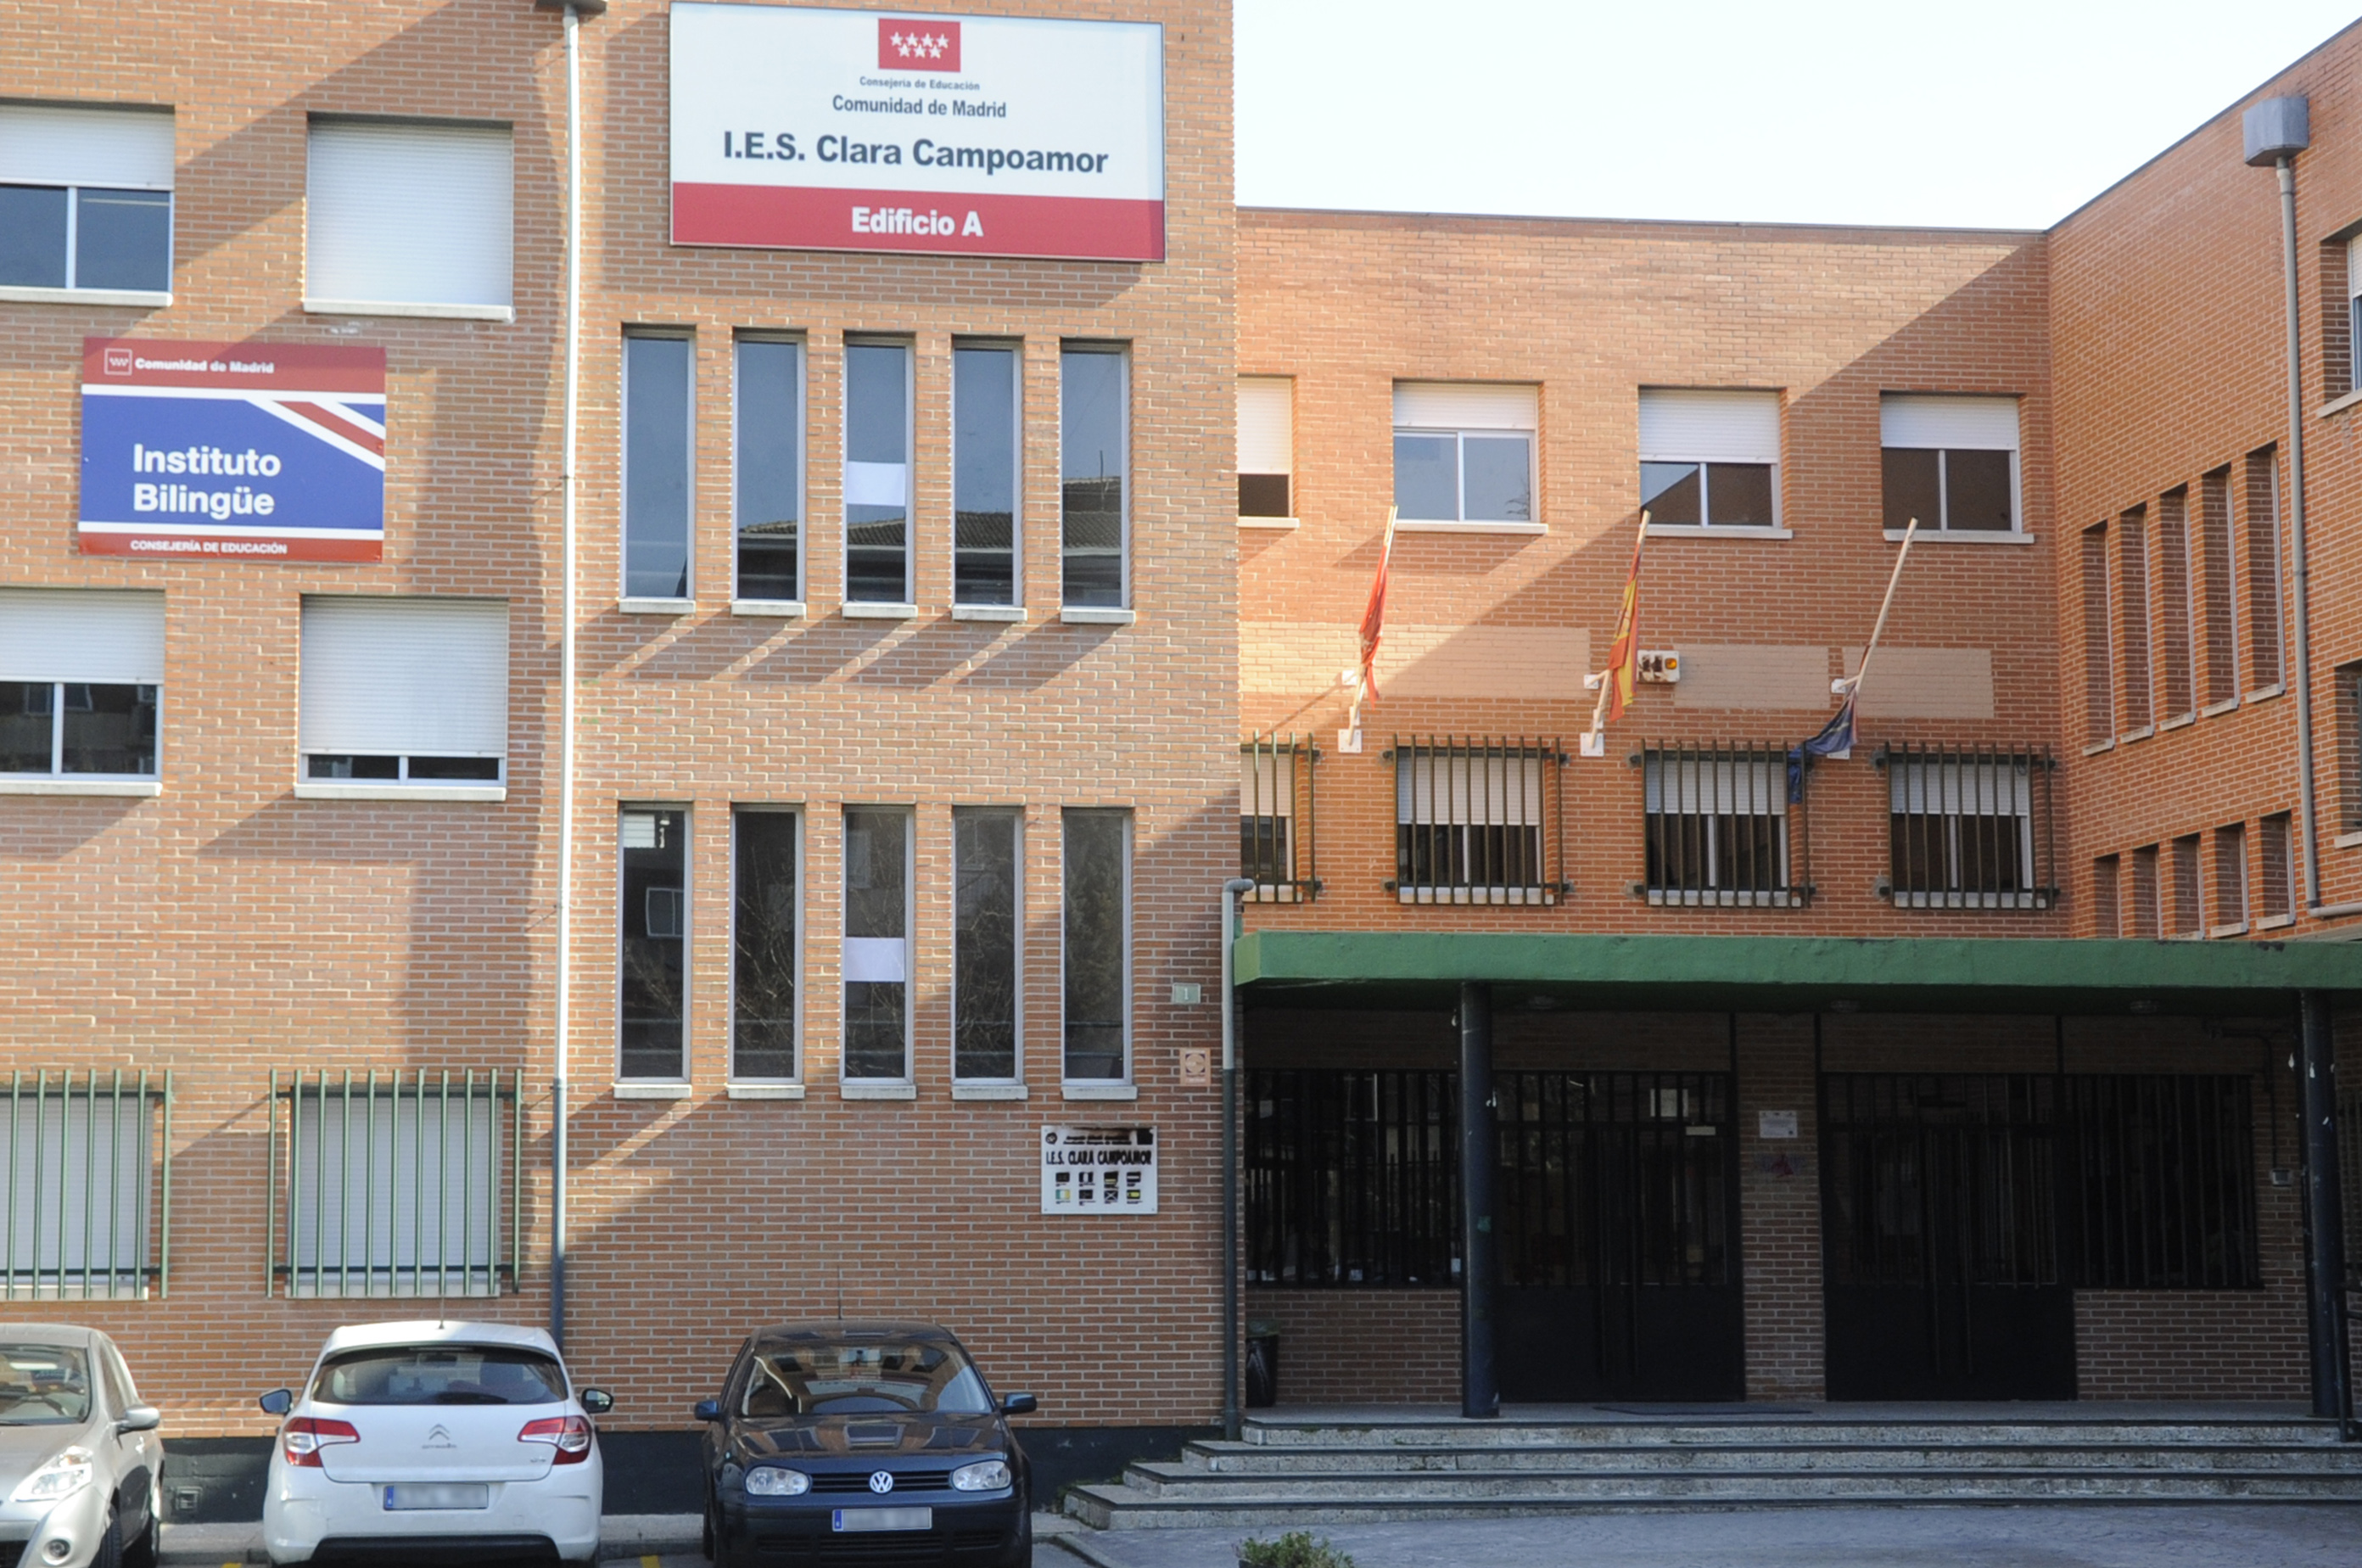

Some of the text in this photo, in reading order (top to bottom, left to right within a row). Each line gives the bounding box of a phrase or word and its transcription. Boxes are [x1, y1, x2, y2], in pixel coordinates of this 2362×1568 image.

[915, 79, 926, 88] de
[929, 79, 980, 91] Educación
[832, 94, 1006, 118] Comunidad de Madrid
[725, 131, 1109, 176] I.E.S. Clara Campoamor
[852, 206, 984, 237] Edificio A
[135, 357, 275, 374] Comunidad de Madrid
[133, 443, 282, 477] Instituto
[133, 483, 275, 520] Bilingüe
[203, 542, 220, 552] DE
[1068, 1151, 1094, 1165] CLARA
